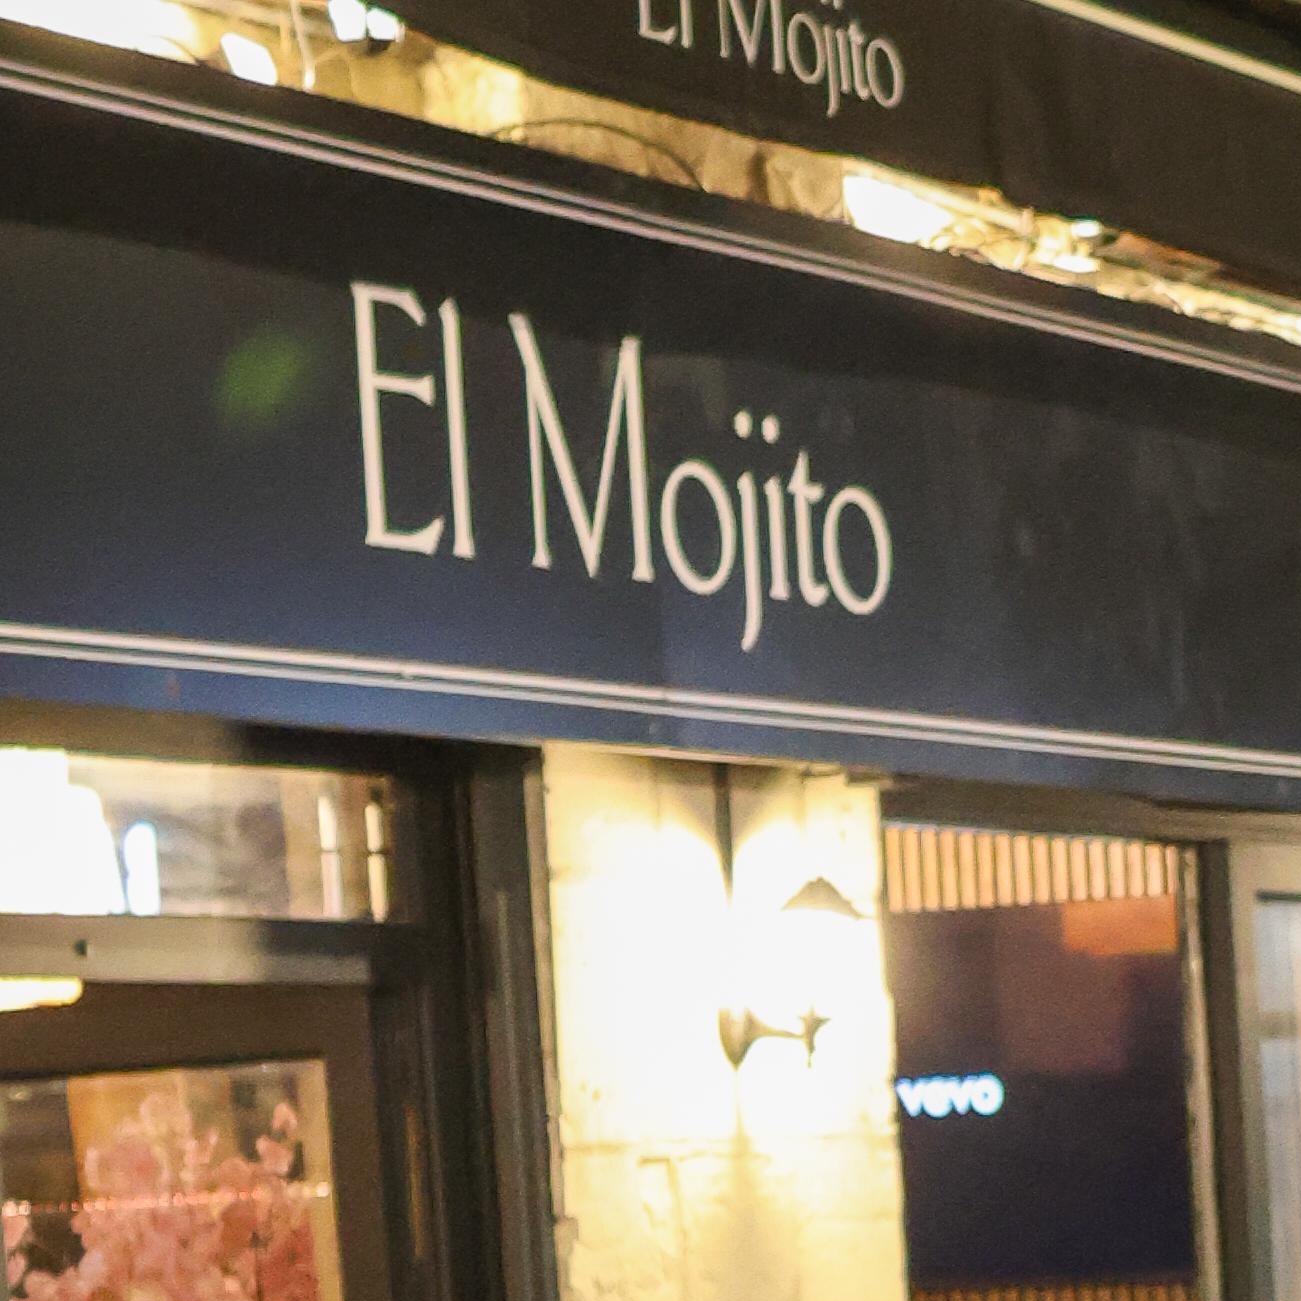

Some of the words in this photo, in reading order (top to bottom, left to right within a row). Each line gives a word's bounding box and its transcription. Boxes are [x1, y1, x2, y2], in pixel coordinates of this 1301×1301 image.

[350, 281, 475, 559] El
[508, 312, 893, 652] Mojito
[896, 1073, 1004, 1118] vevo
